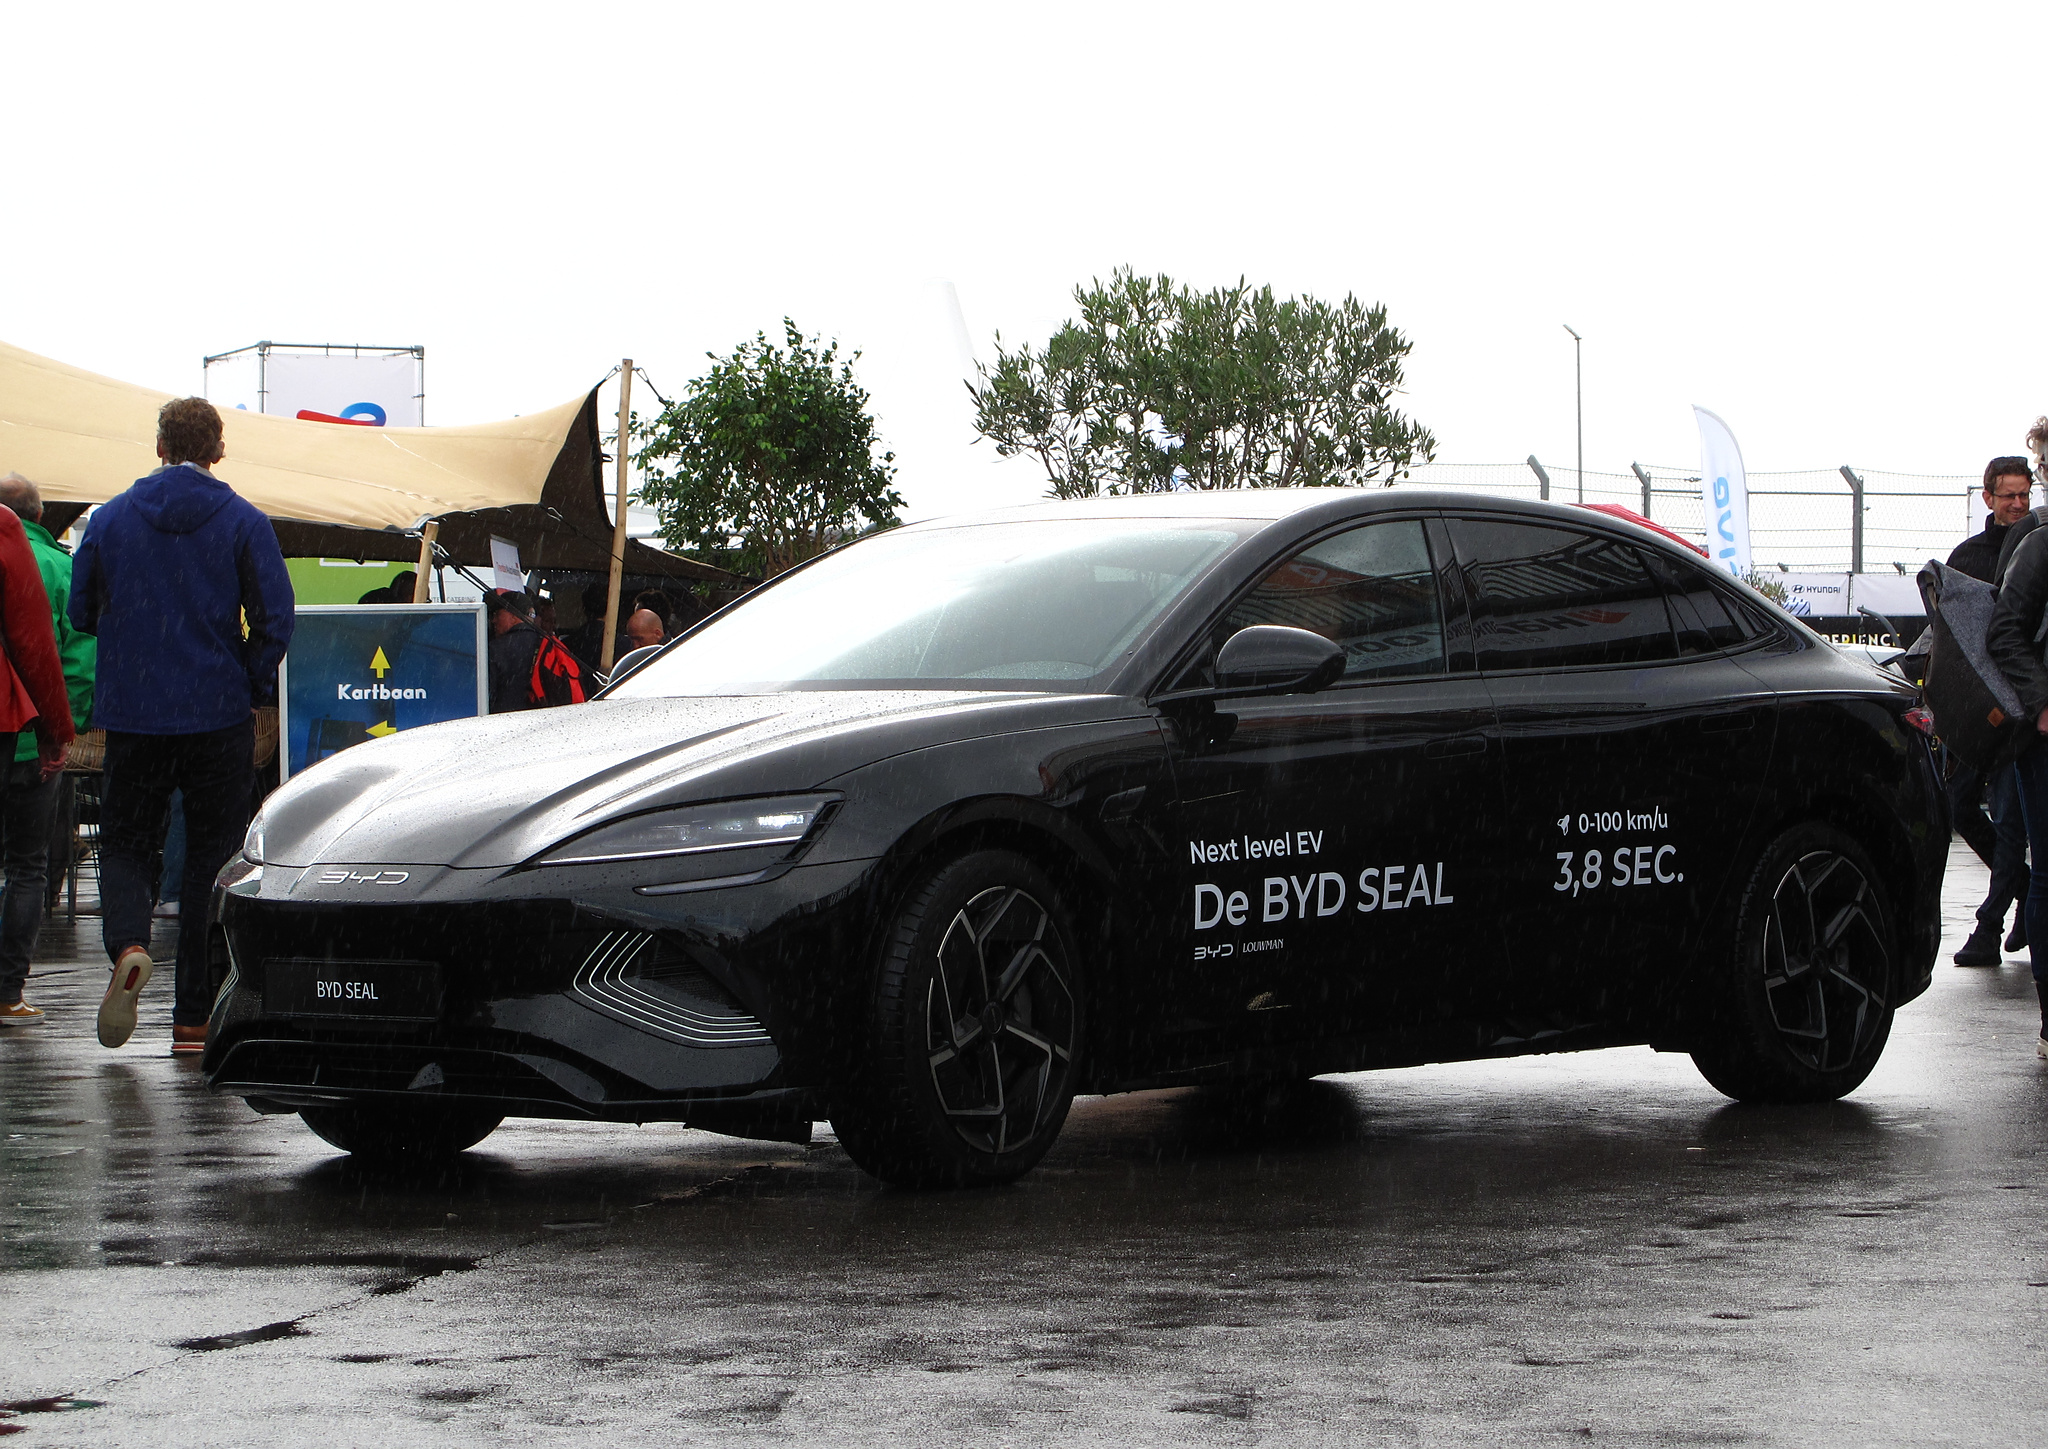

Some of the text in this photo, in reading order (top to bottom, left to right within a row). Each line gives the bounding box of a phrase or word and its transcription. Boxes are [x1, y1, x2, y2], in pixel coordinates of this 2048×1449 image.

[1806, 586, 1841, 594] HYUNDAI
[337, 683, 427, 700] Kartbaan
[1578, 805, 1668, 834] 0-100 km/u
[1190, 830, 1324, 864] Next level EV
[317, 871, 410, 885] BYD
[1553, 844, 1684, 897] 3,8 SEC.
[1194, 861, 1454, 930] De BYD SEAL
[1194, 938, 1285, 960] BYD LOUWMAN
[316, 980, 379, 1000] BYD SEAL
